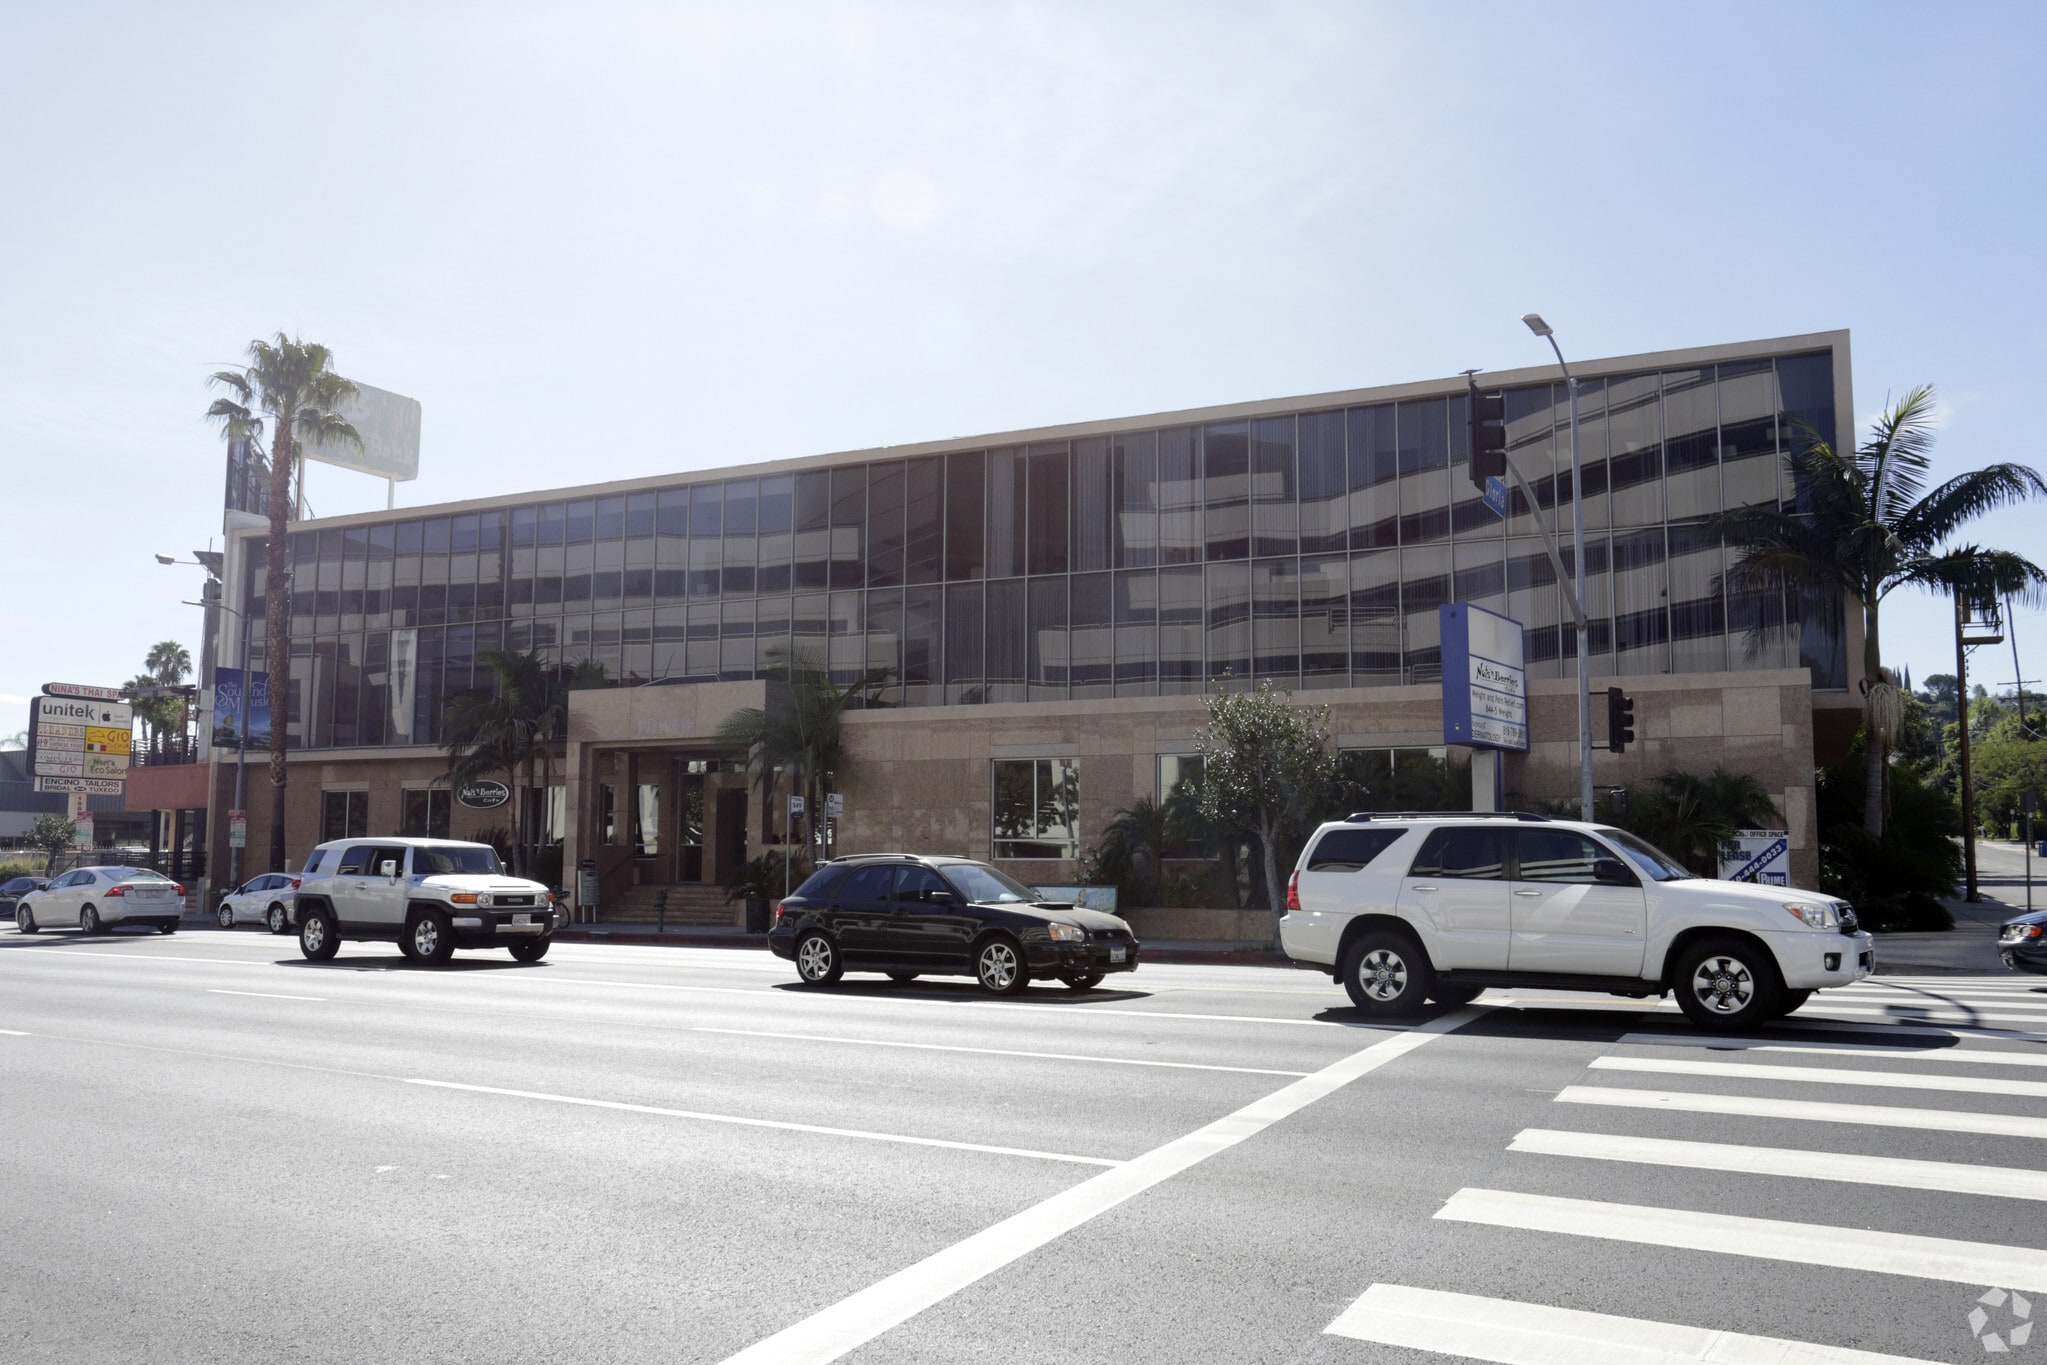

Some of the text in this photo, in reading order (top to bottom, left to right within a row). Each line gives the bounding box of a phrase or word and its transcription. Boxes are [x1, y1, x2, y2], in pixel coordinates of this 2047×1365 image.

[1485, 479, 1505, 509] Gloria
[51, 684, 80, 694] NINA'S
[83, 687, 103, 697] THAI
[42, 703, 95, 720] unitek
[107, 730, 130, 742] GIO
[90, 766, 104, 774] Eco
[44, 778, 120, 788] ENCINO TAILORS
[1760, 873, 1785, 886] PRIME
